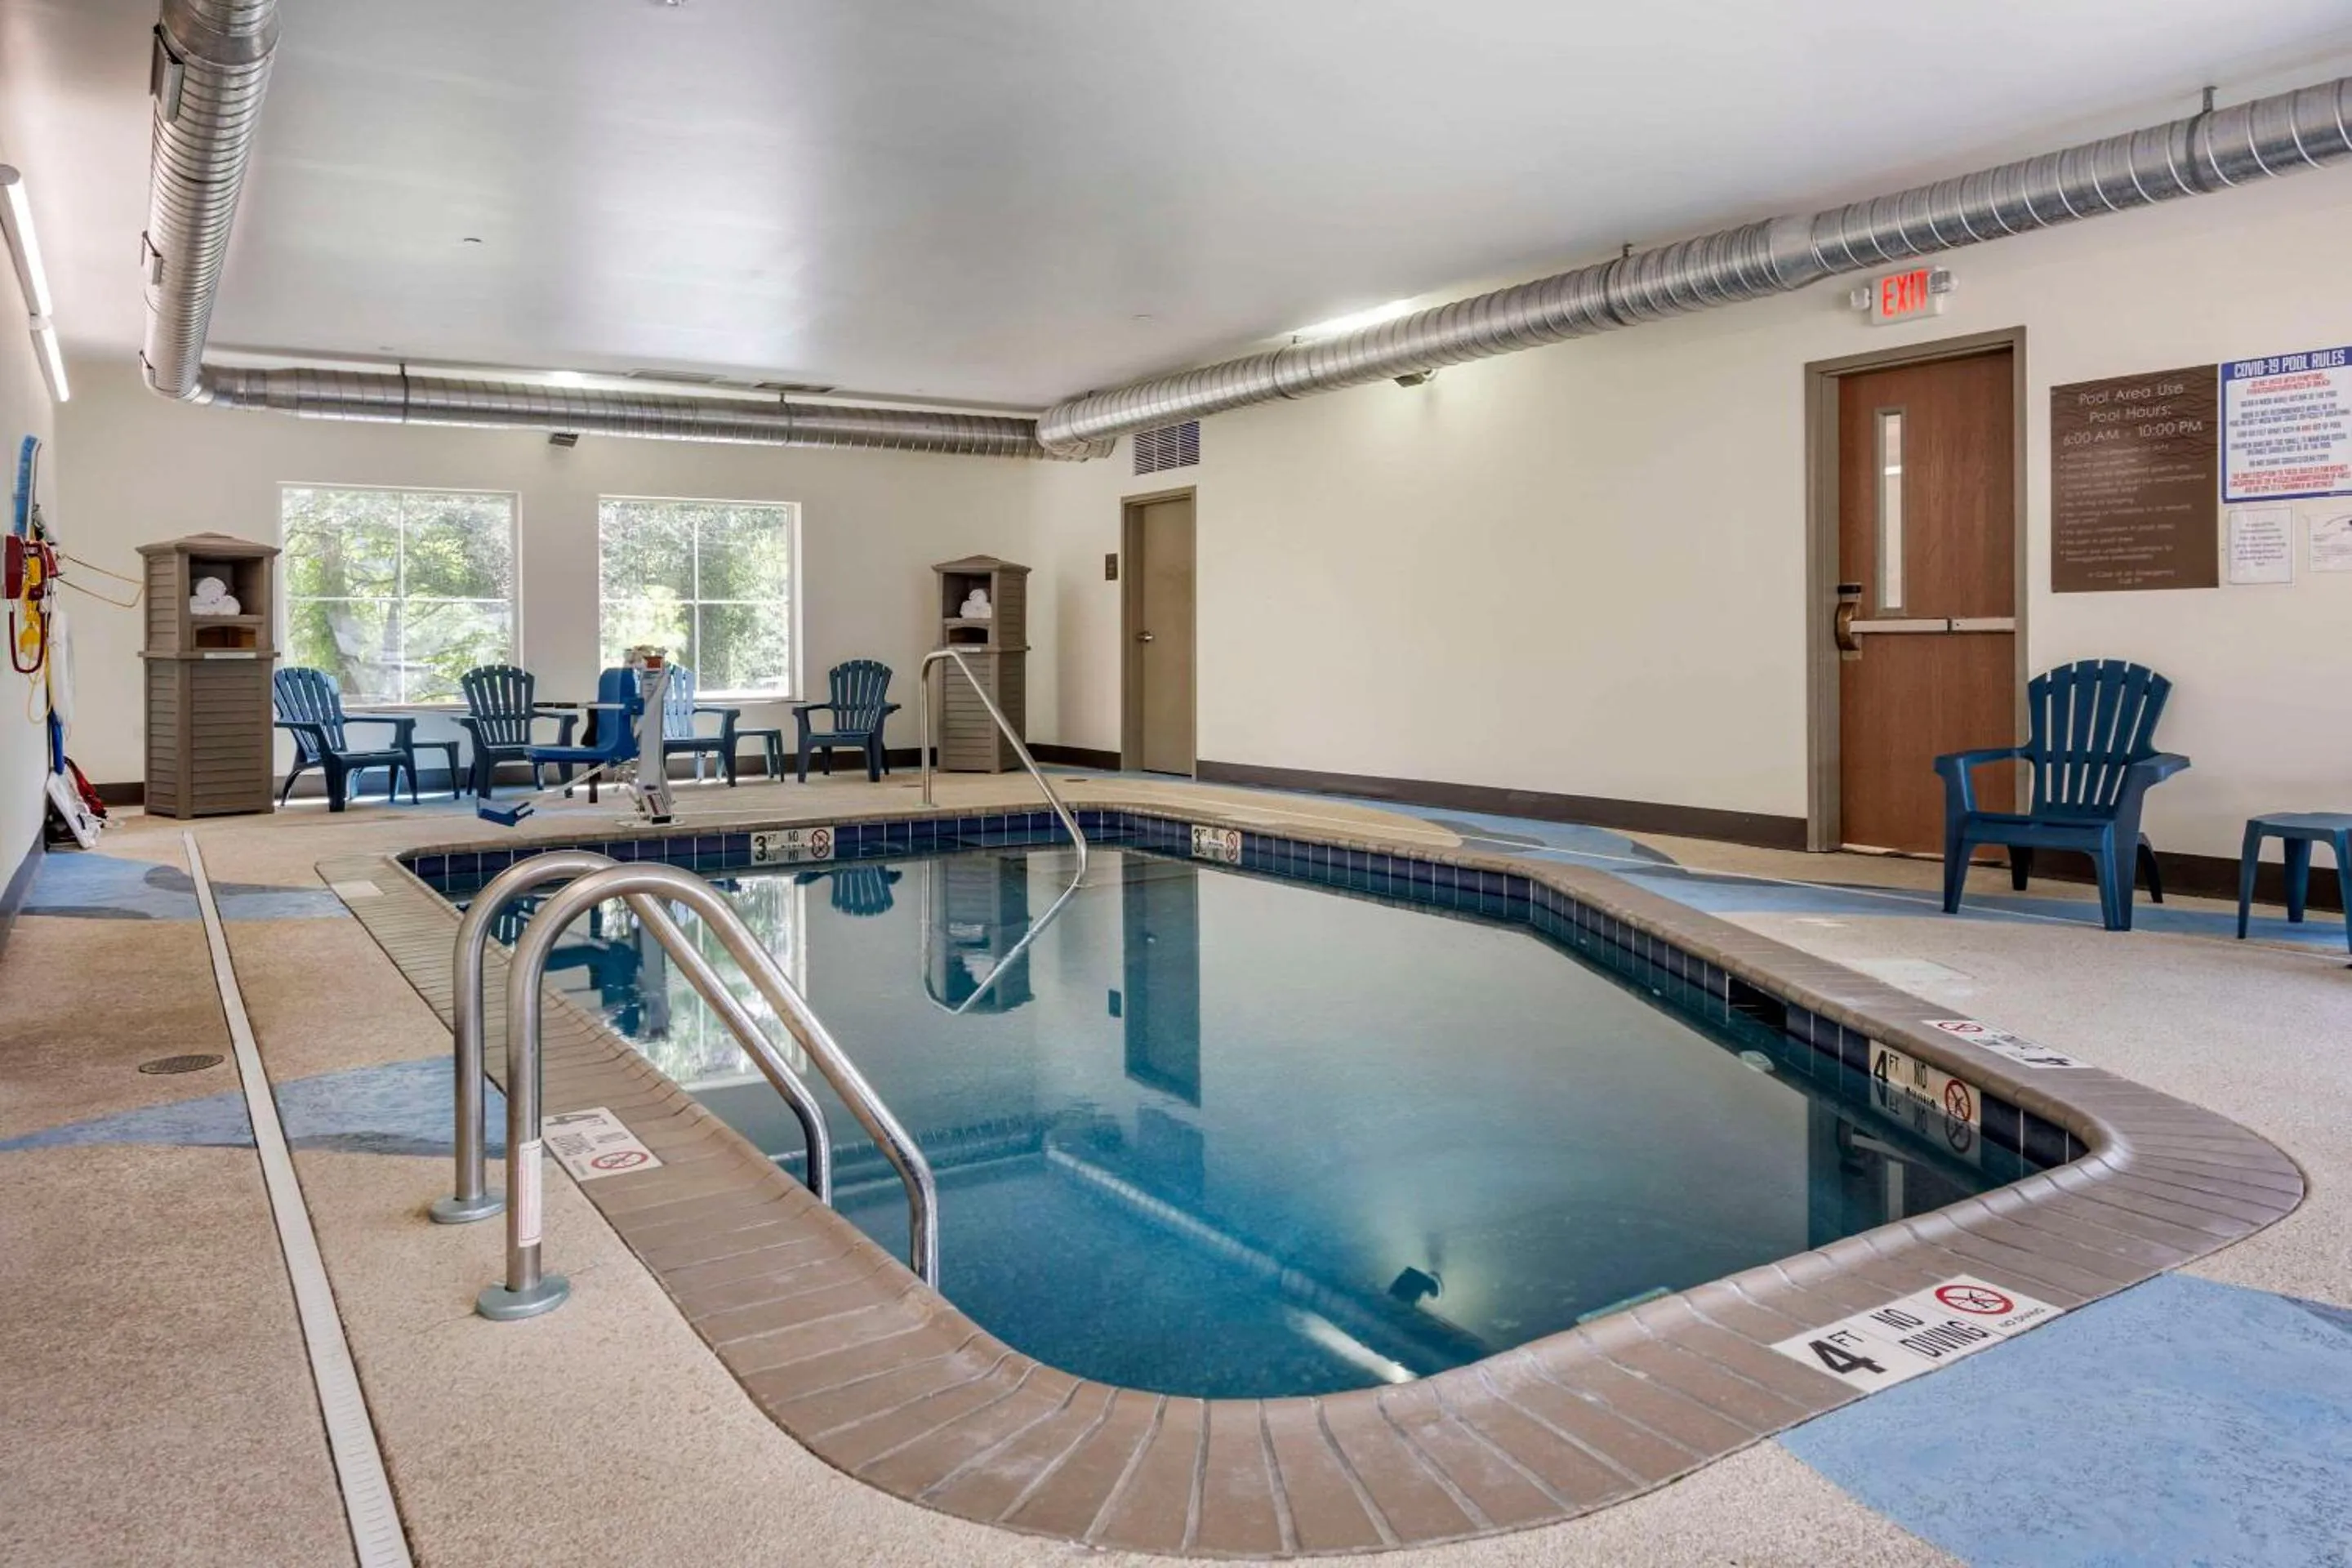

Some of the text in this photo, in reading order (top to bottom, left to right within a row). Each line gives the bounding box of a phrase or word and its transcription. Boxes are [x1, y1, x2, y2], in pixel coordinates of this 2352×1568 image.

[1882, 268, 1928, 318] EXIT
[2234, 350, 2345, 378] COVID-19 POOL RULES
[2079, 384, 2184, 405] Pool Area Use
[2090, 405, 2172, 423] Pool Hours:
[2063, 431, 2091, 447] 6:00
[2095, 430, 2120, 443] AM
[2139, 422, 2175, 437] 10:00
[2179, 421, 2203, 434] PM
[1874, 1049, 1900, 1082] 4 FT
[1913, 1060, 1927, 1088] NO
[1869, 1308, 1926, 1331] NO
[1808, 1330, 1888, 1374] 4 FT
[1898, 1321, 1990, 1357] DIVING
